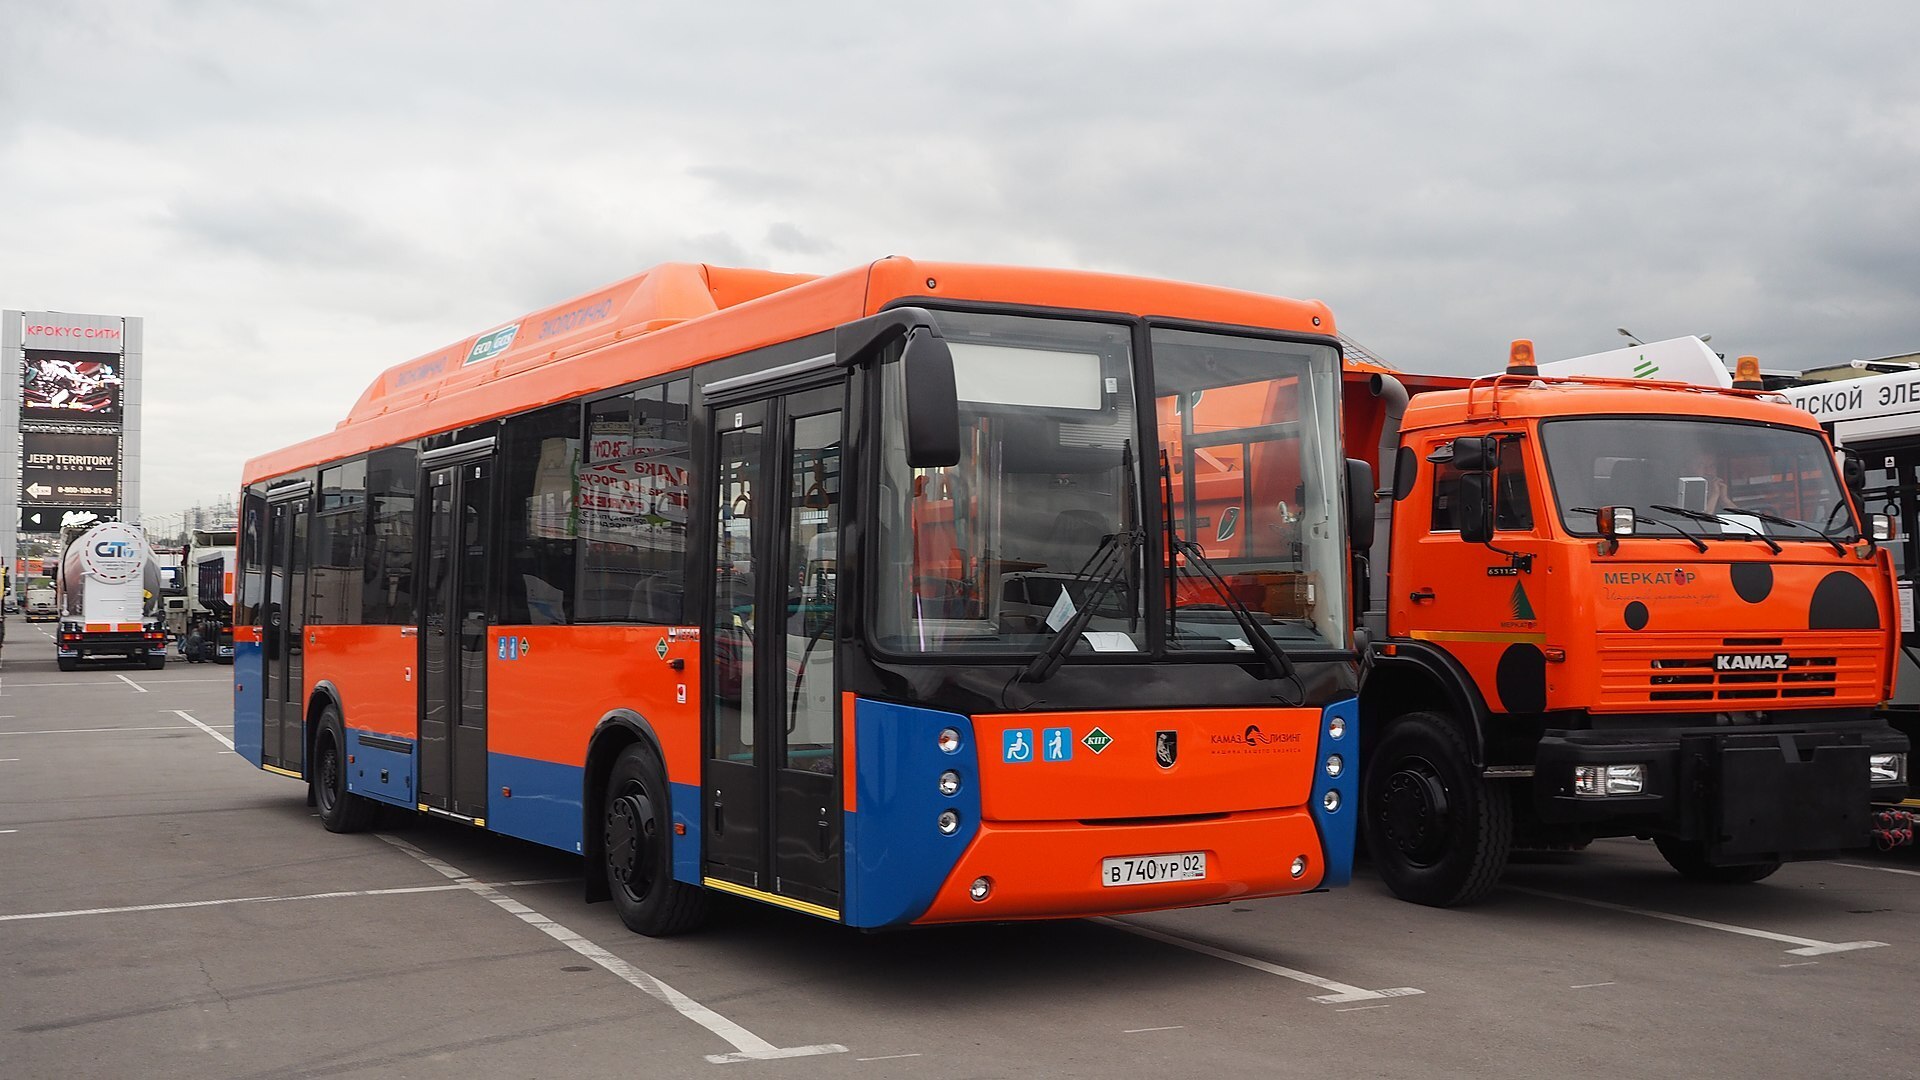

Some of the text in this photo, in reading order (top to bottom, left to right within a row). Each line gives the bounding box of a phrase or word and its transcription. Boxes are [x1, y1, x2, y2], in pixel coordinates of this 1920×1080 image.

[27, 325, 120, 339] КРОКУС СИТИ
[27, 454, 54, 464] JEEP
[1717, 655, 1787, 670] KAMAZ
[1087, 736, 1108, 745] КПГ
[1211, 733, 1301, 744] КАМАЗ ЛИЗИНГ
[1183, 855, 1200, 871] 02
